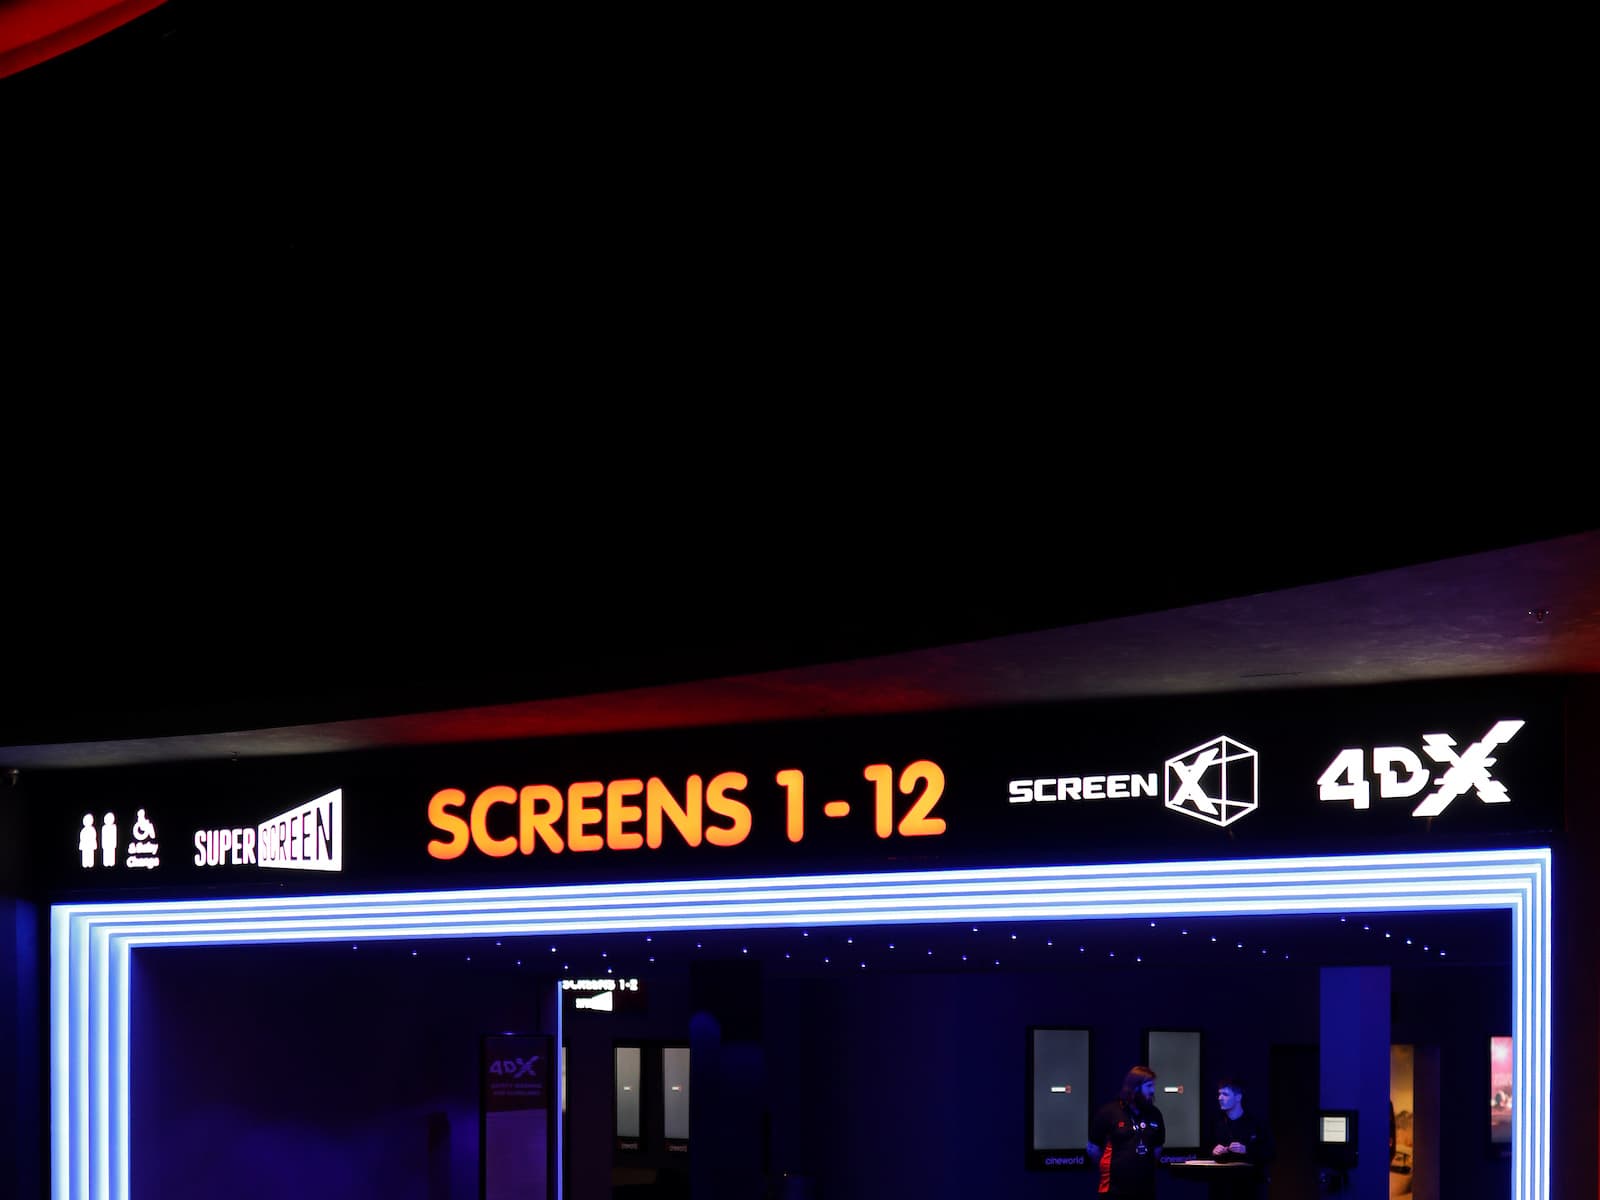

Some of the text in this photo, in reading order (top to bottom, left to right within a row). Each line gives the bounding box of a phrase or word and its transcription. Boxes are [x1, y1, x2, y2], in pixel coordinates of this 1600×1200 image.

[1008, 772, 1159, 804] SCREEN
[1317, 719, 1526, 818] 4DX
[427, 770, 753, 861] SCREENS
[775, 768, 805, 843] 1
[863, 759, 947, 838] 12
[194, 827, 257, 867] SUPER
[488, 1055, 540, 1079] 4DX
